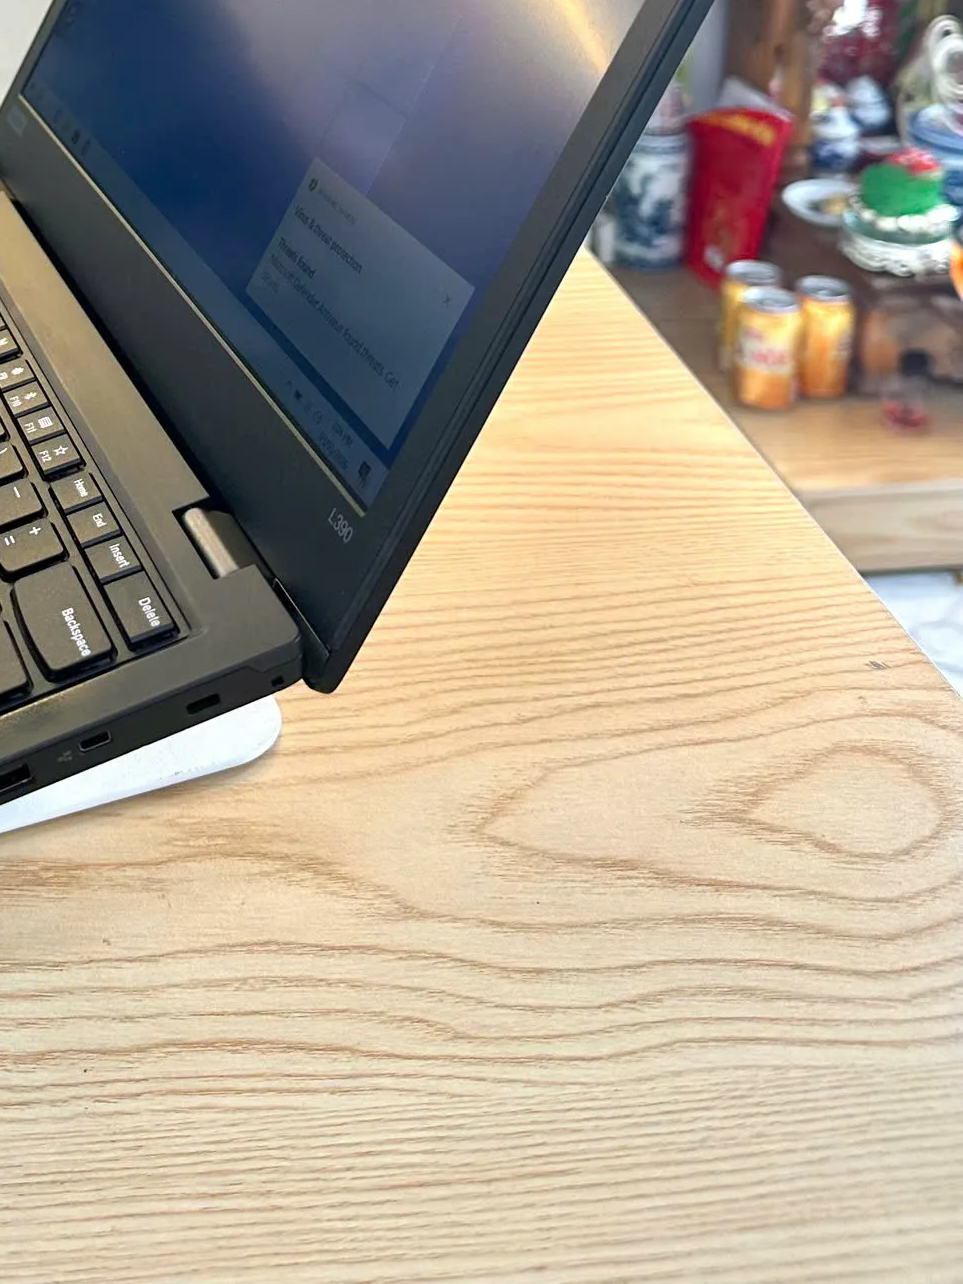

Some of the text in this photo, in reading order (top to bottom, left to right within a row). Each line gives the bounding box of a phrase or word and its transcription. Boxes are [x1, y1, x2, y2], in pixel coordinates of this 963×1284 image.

[296, 255, 316, 280] found
[329, 238, 364, 276] protection
[24, 422, 37, 434] F11
[38, 450, 52, 464] F12
[73, 478, 88, 498] Home
[92, 512, 107, 528] End
[327, 507, 354, 544] L390
[109, 543, 131, 568] Insert
[138, 596, 161, 628] Delete
[61, 607, 92, 657] Backspace
